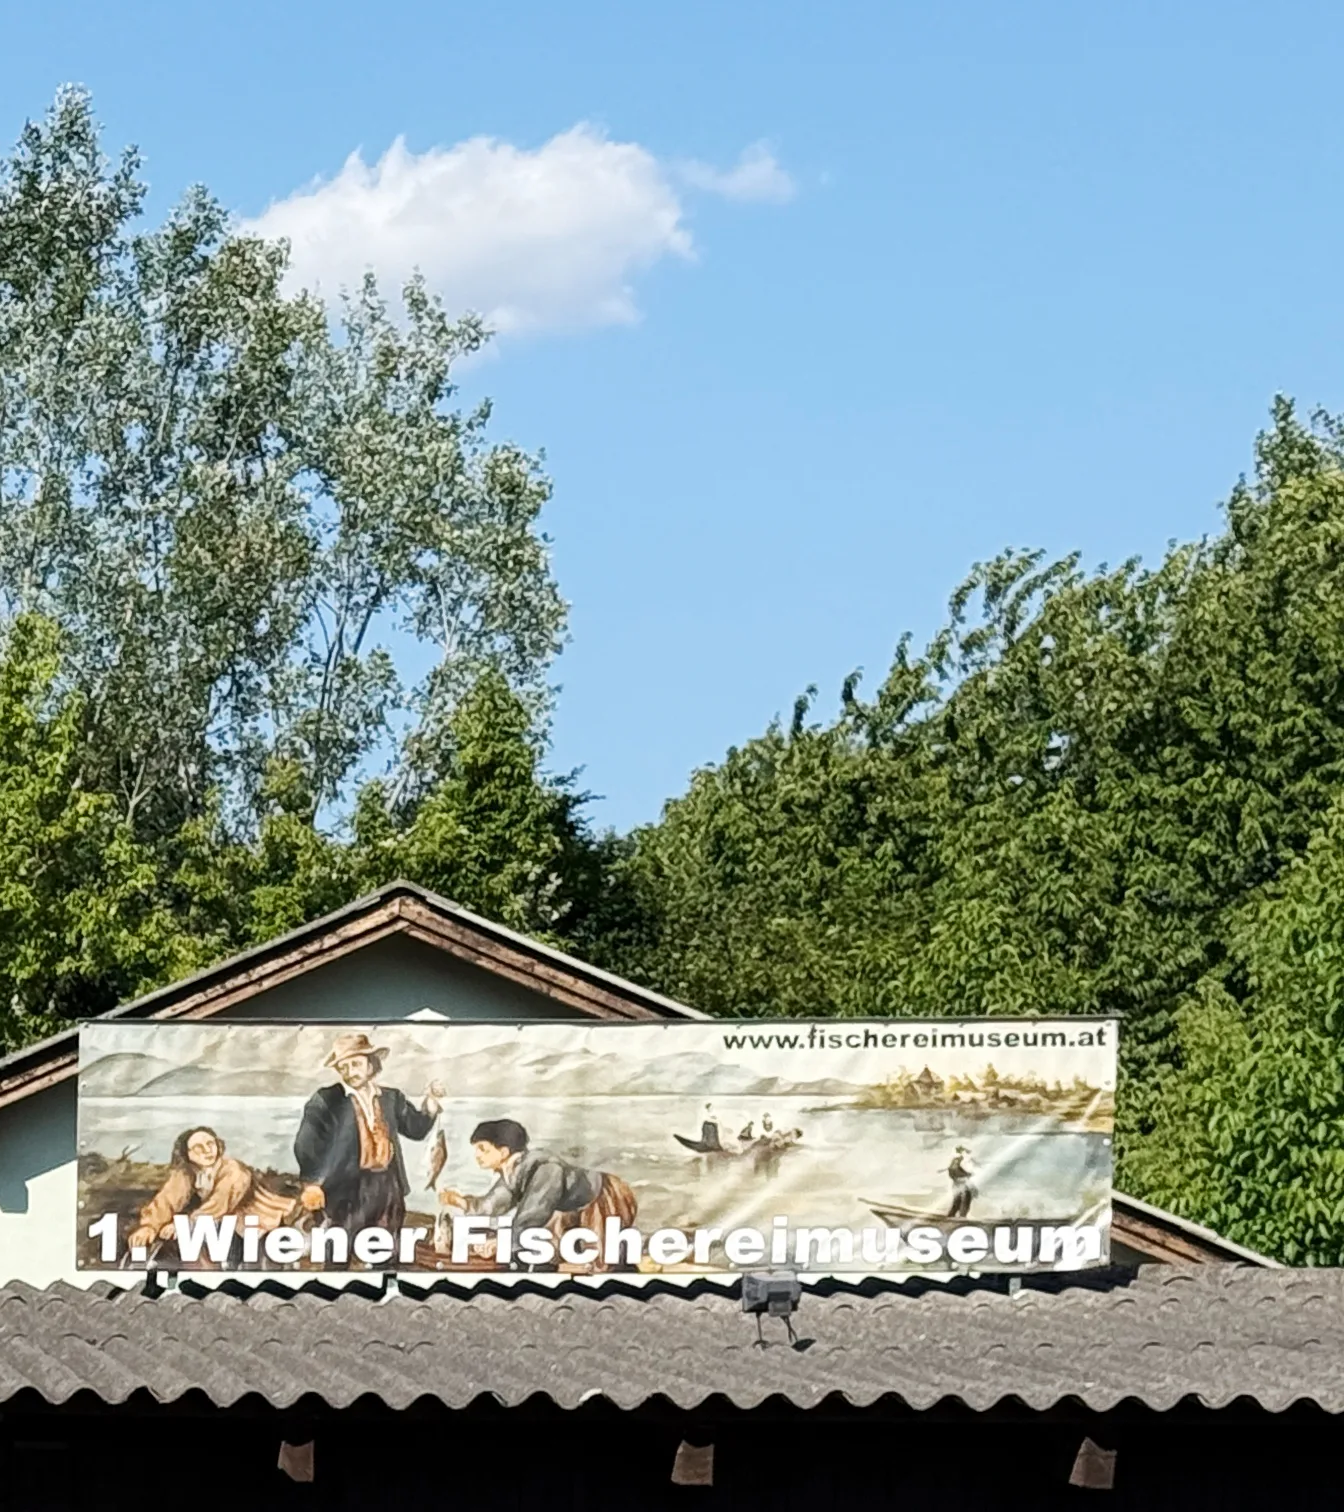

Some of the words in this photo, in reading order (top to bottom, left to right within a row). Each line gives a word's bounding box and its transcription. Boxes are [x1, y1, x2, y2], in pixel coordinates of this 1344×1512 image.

[723, 1025, 1108, 1050] www.fischereimuseum.at
[87, 1212, 148, 1263] 1.
[173, 1214, 429, 1265] Wiener
[450, 1215, 1102, 1265] Fischereimuseum
